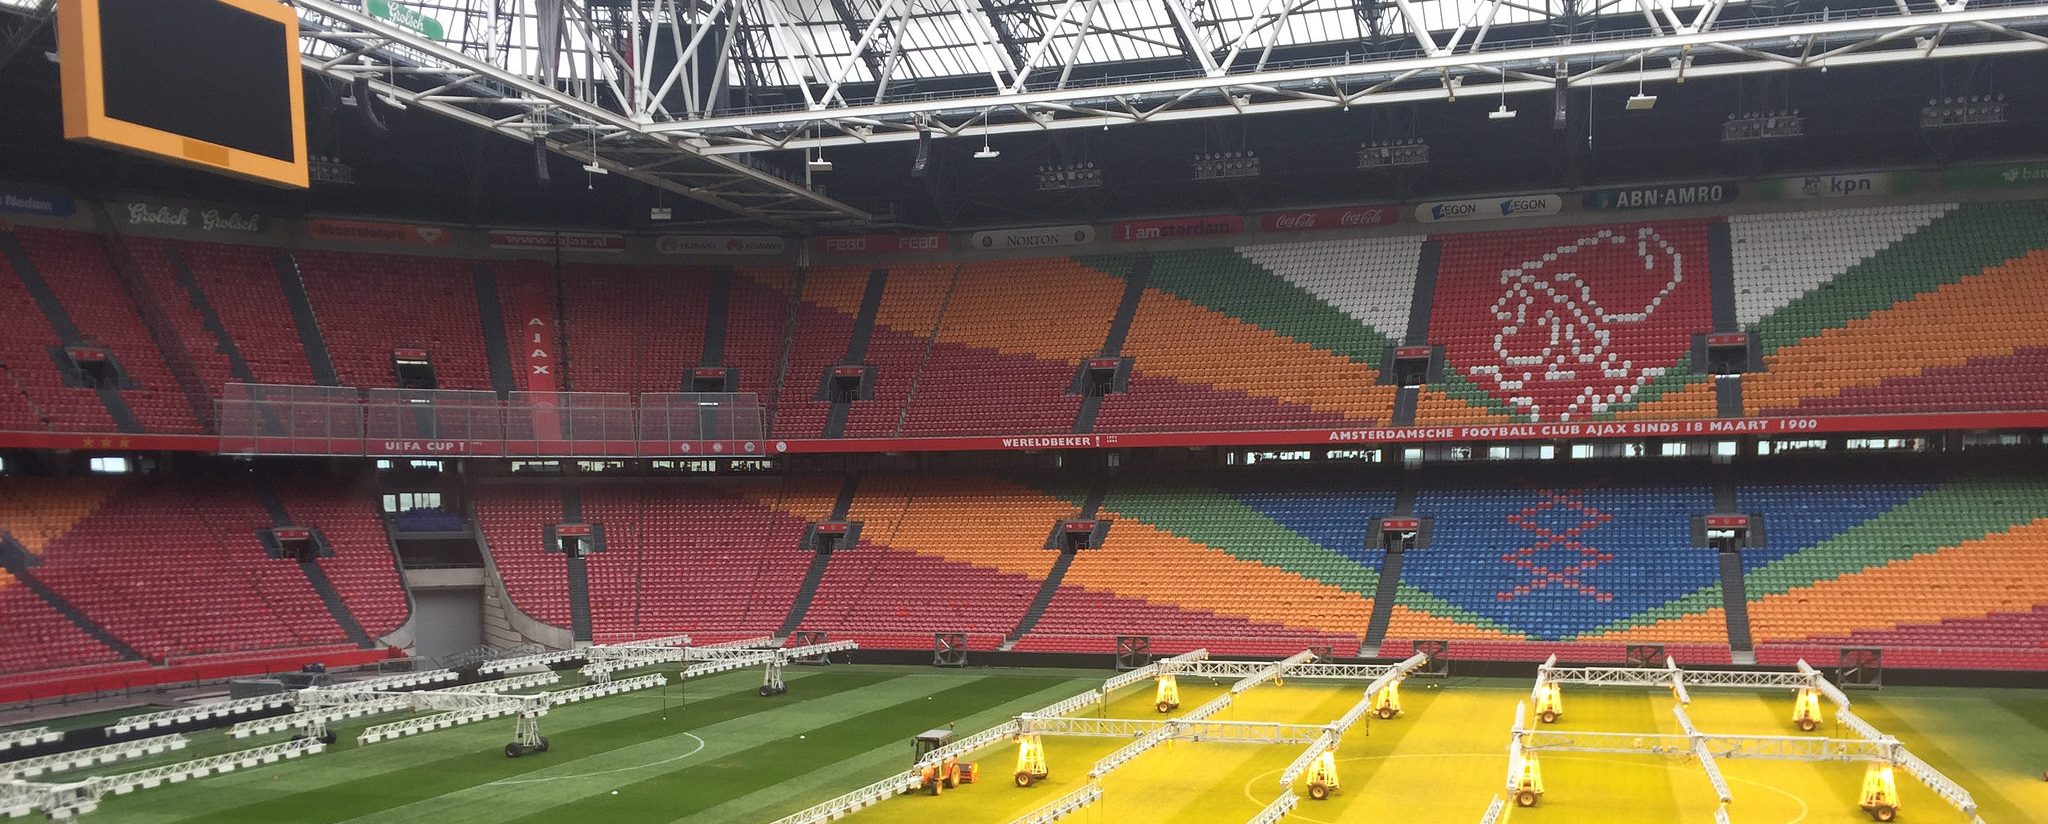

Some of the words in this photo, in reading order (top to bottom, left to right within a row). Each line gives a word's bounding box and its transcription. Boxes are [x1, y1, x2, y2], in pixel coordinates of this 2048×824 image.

[386, 0, 424, 30] Grolsch
[1829, 175, 1872, 195] kpn
[128, 203, 189, 226] Grolsch
[201, 210, 259, 230] Grolsch
[1433, 203, 1476, 219] AEGON
[1500, 199, 1546, 216] AEGON
[1007, 233, 1059, 247] NORTON
[1124, 224, 1131, 240] I
[1135, 223, 1230, 239] amsterdam
[827, 239, 866, 250] FEBO
[899, 237, 938, 249] FEBO
[528, 317, 550, 374] AJAX
[1328, 428, 1454, 440] AMSTERDAMSCHE
[1462, 426, 1536, 437] FOOTBALL
[1541, 425, 1580, 435] CLUB
[1585, 424, 1627, 436] AJAX
[1633, 423, 1679, 433] SINDS
[1685, 421, 1704, 431] 18
[1710, 420, 1769, 431] MAART
[1779, 419, 1818, 430] 1900
[385, 441, 420, 450] UEFA
[426, 441, 453, 450] CUP
[1002, 437, 1091, 447] WERELDBEKER
